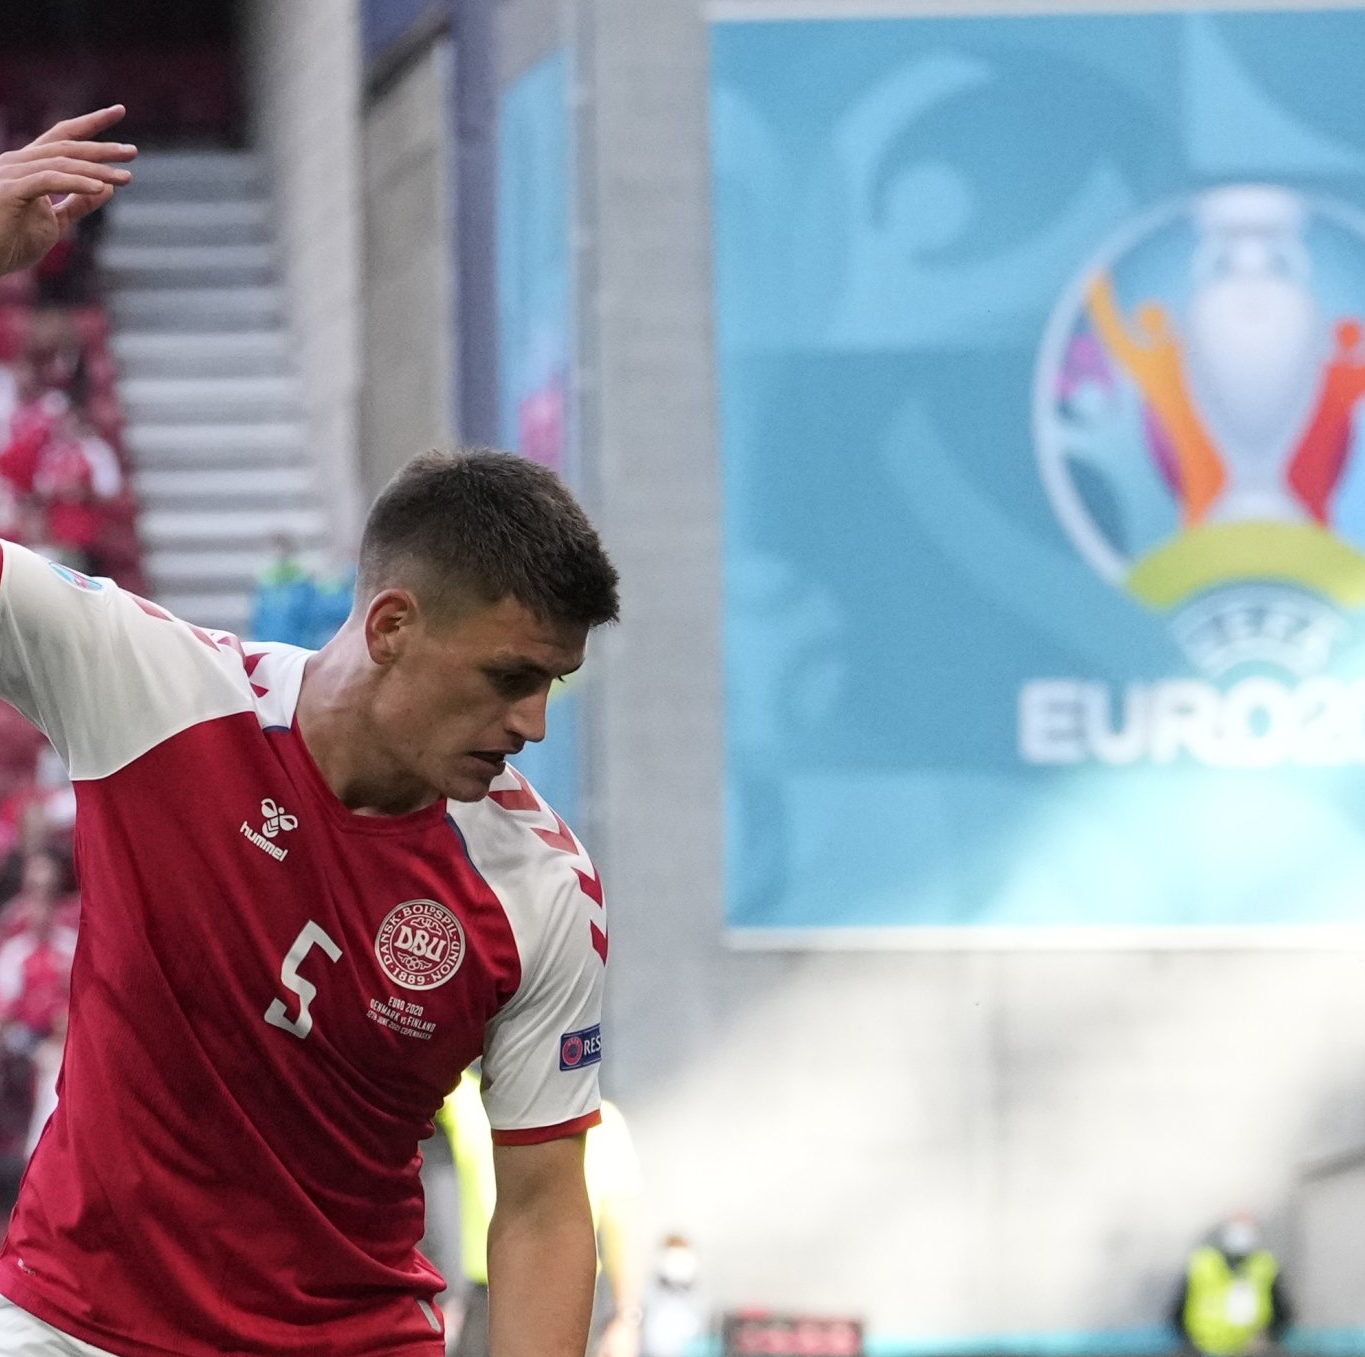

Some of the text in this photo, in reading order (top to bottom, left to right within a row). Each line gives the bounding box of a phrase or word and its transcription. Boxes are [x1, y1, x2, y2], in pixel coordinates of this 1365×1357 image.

[239, 820, 289, 862] hummel
[380, 914, 401, 966] DANSK
[392, 966, 426, 985] 1889
[393, 925, 447, 962] DBU
[264, 919, 343, 1039] 5
[370, 999, 400, 1021] DENMARK
[406, 1015, 437, 1033] FINLAND
[388, 996, 424, 1016] EURO 2020
